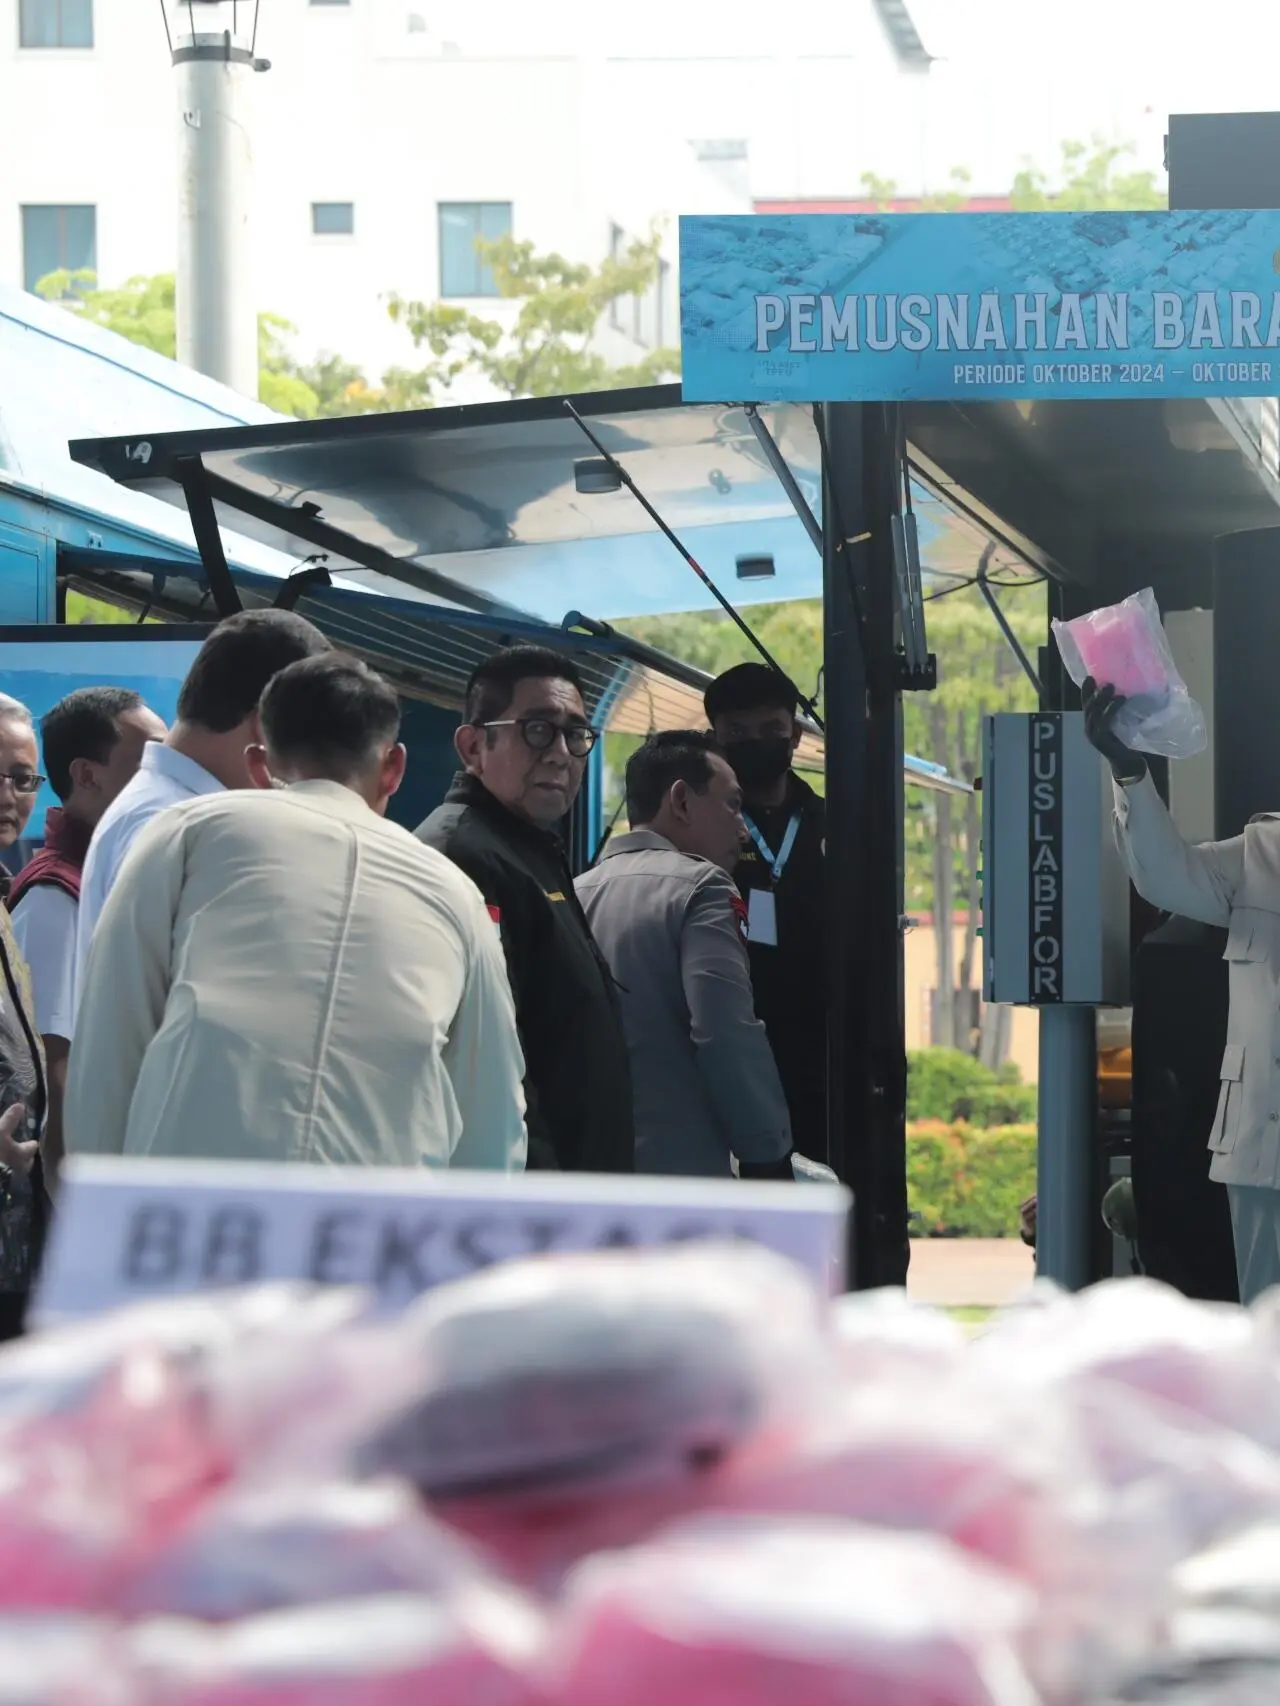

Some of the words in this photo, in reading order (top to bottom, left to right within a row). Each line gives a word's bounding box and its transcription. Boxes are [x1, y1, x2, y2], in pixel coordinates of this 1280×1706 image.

[754, 290, 1130, 353] PEMUSNAHAN
[953, 364, 1026, 384] PERIODE
[1033, 364, 1112, 383] OKTOBER
[1119, 363, 1165, 382] 2024
[1192, 362, 1272, 382] OKTOBER
[1032, 721, 1060, 994] PUSLABFOR
